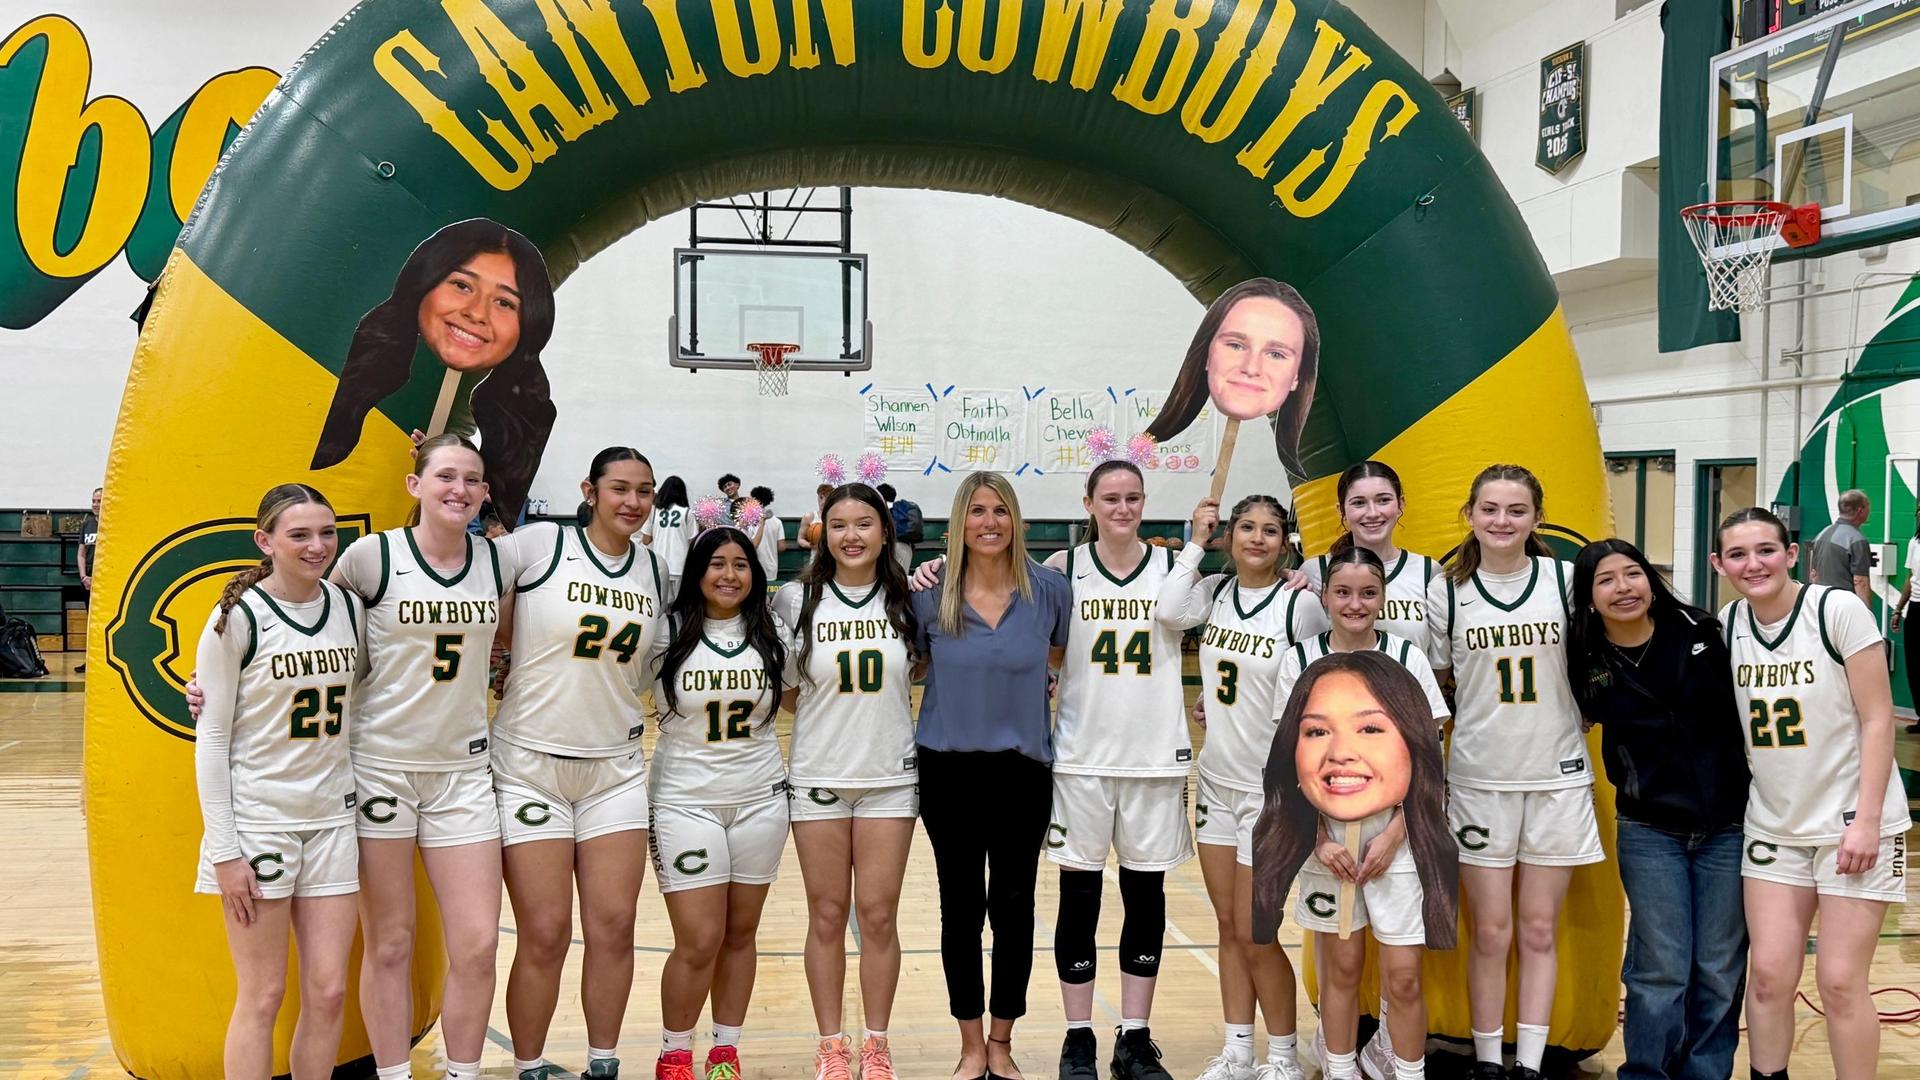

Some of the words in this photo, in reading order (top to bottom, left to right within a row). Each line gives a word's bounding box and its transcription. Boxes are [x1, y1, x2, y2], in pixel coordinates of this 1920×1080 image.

[874, 416, 916, 433] Wilson
[963, 397, 1009, 418] Faith
[1050, 397, 1094, 421] Bella
[880, 435, 914, 455] #44
[947, 421, 1010, 443] Obtinalla
[659, 511, 681, 529] 32
[398, 600, 497, 625] COWBOYS
[567, 581, 654, 618] COWBOYS
[1081, 598, 1158, 621] COWBOY
[572, 614, 643, 664] 24
[1090, 628, 1152, 677] 44
[1201, 622, 1276, 659] COWBOYS
[1465, 621, 1561, 651] COWBOYS
[271, 647, 357, 680] COWBOYS
[431, 633, 465, 684] 5
[835, 649, 886, 695] 10
[1737, 660, 1814, 688] COWBOYS
[682, 668, 774, 692] COWBOY
[1215, 659, 1240, 707] 3
[1495, 655, 1538, 705] 11
[288, 685, 348, 741] 25
[704, 700, 755, 744] 12
[1749, 697, 1808, 749] 22
[1892, 832, 1905, 878] COWB
